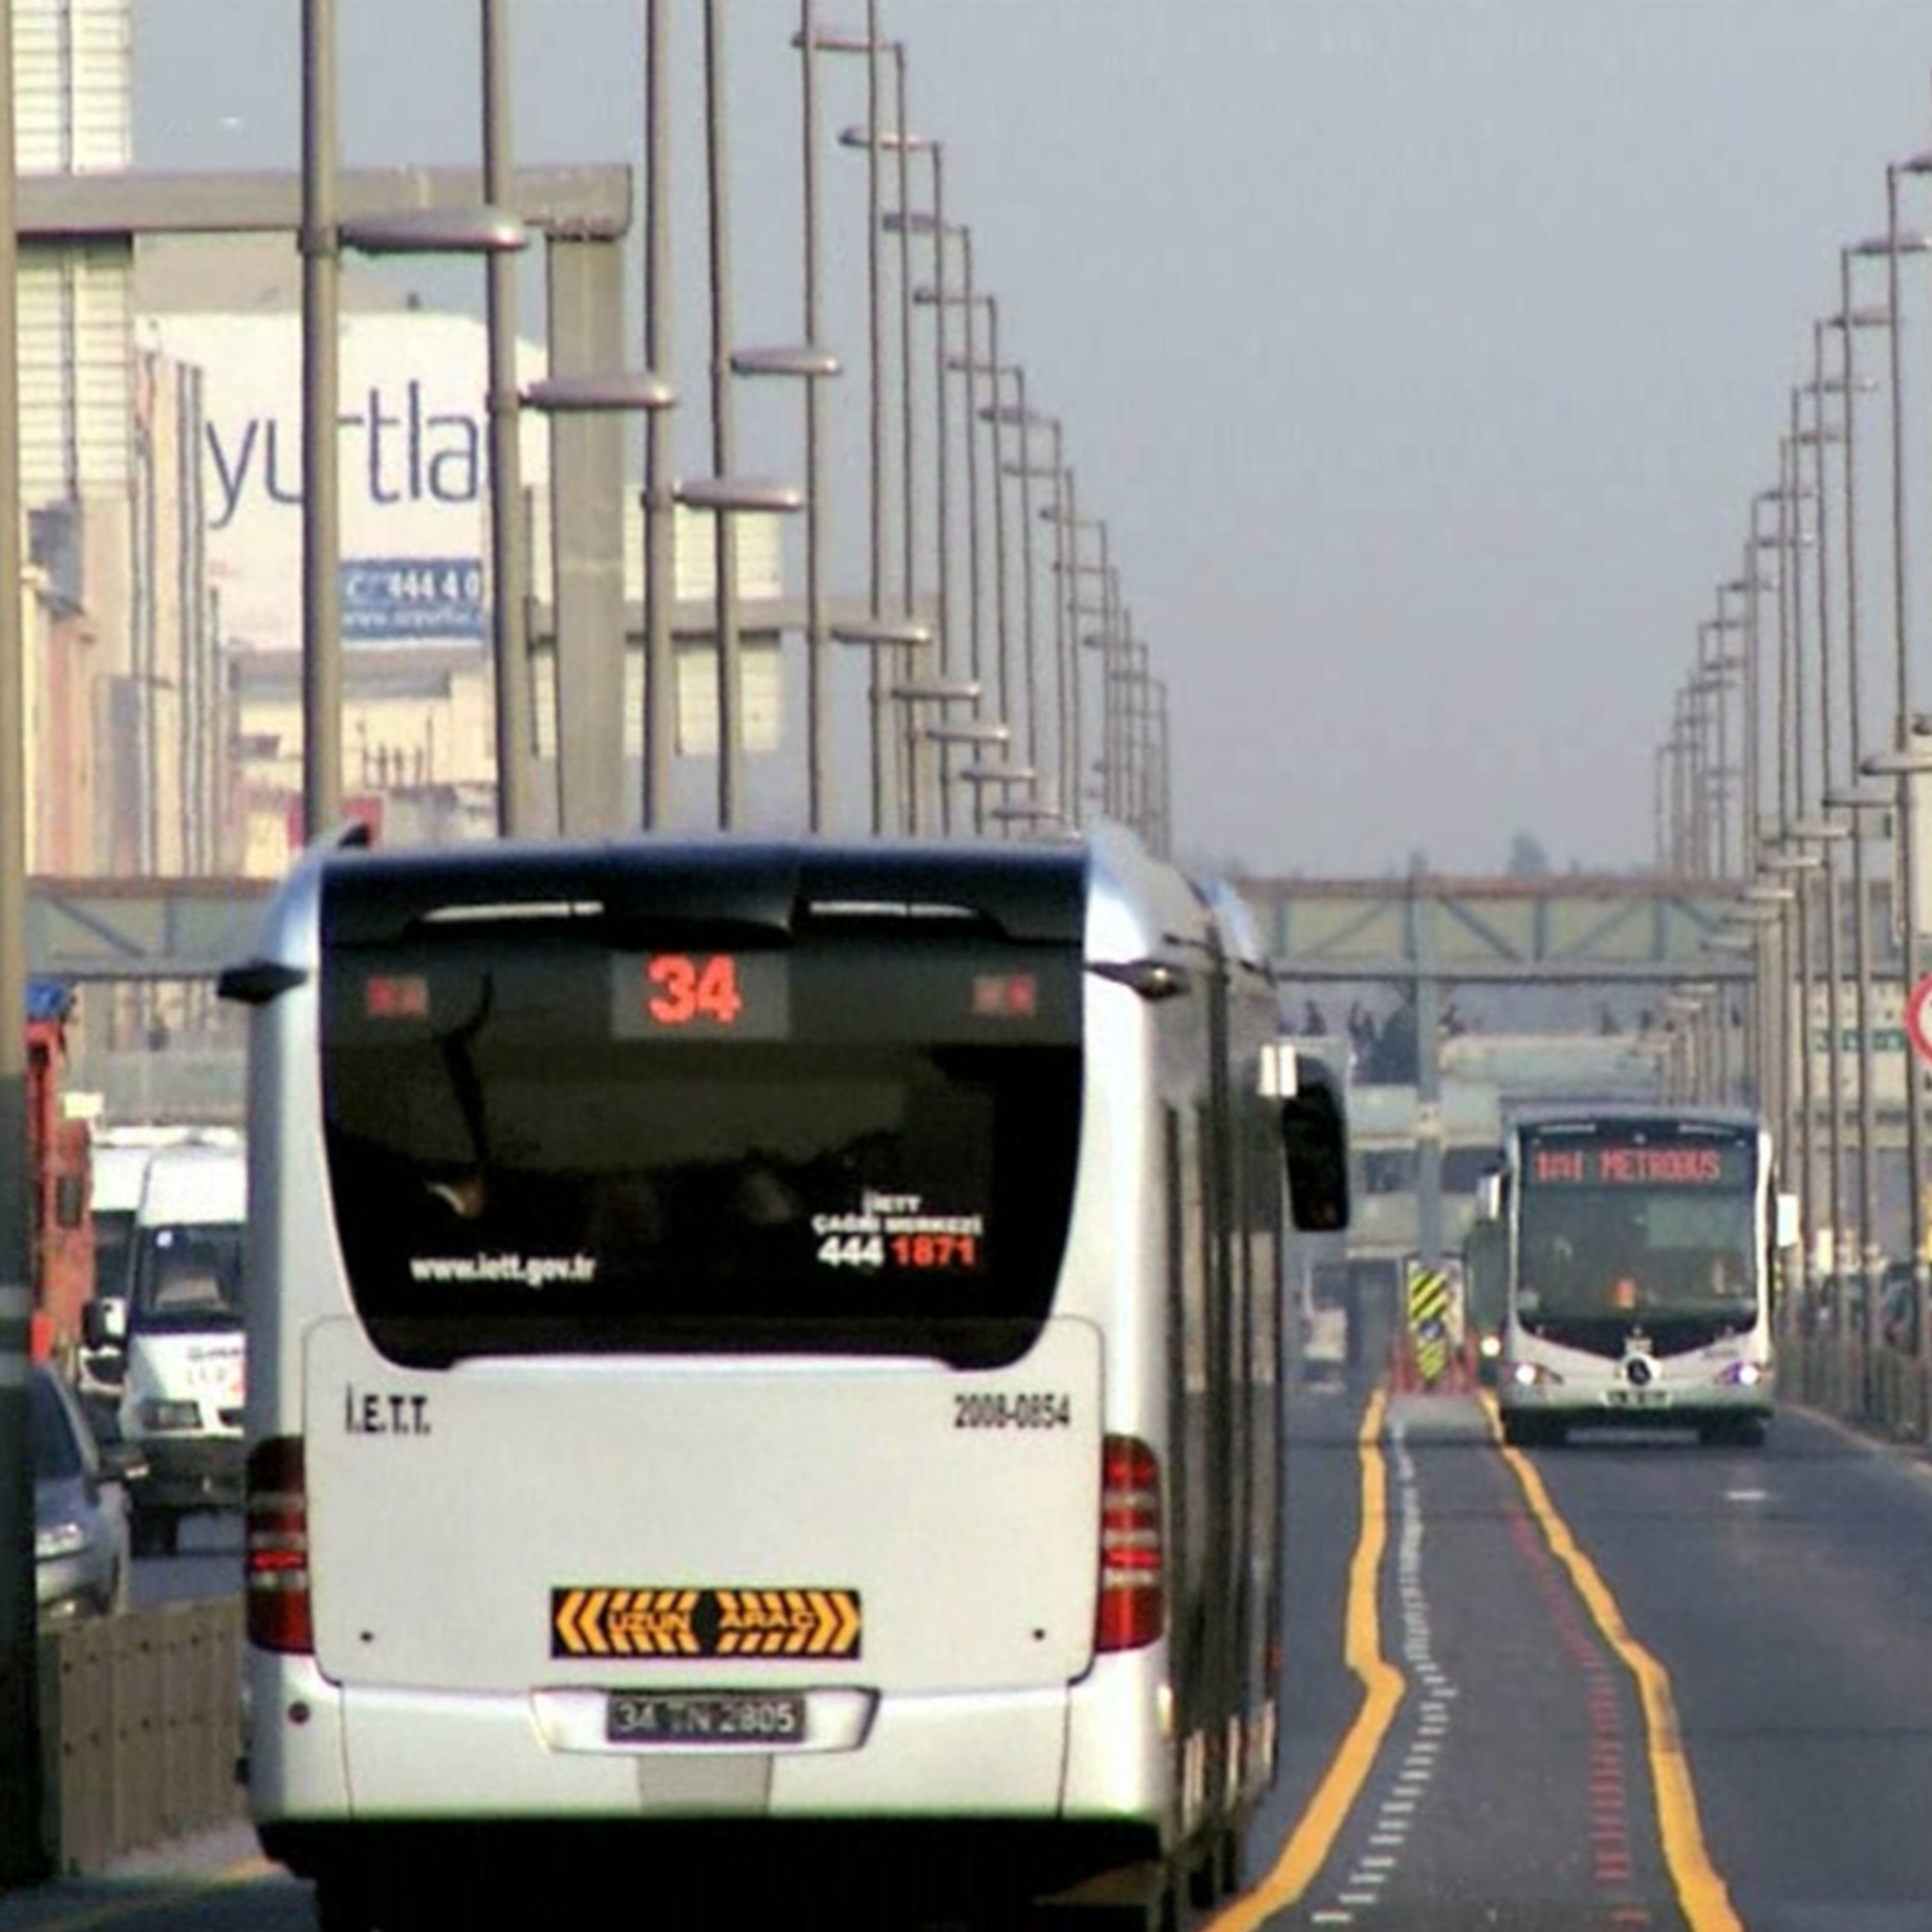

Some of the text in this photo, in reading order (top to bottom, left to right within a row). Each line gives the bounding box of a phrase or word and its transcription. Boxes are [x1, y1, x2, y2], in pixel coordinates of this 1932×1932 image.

[648, 952, 742, 1021] 34
[817, 1235, 975, 1266] 444 1871
[607, 1611, 692, 1634] UZUN
[619, 1701, 796, 1733] 34 TN 2805
